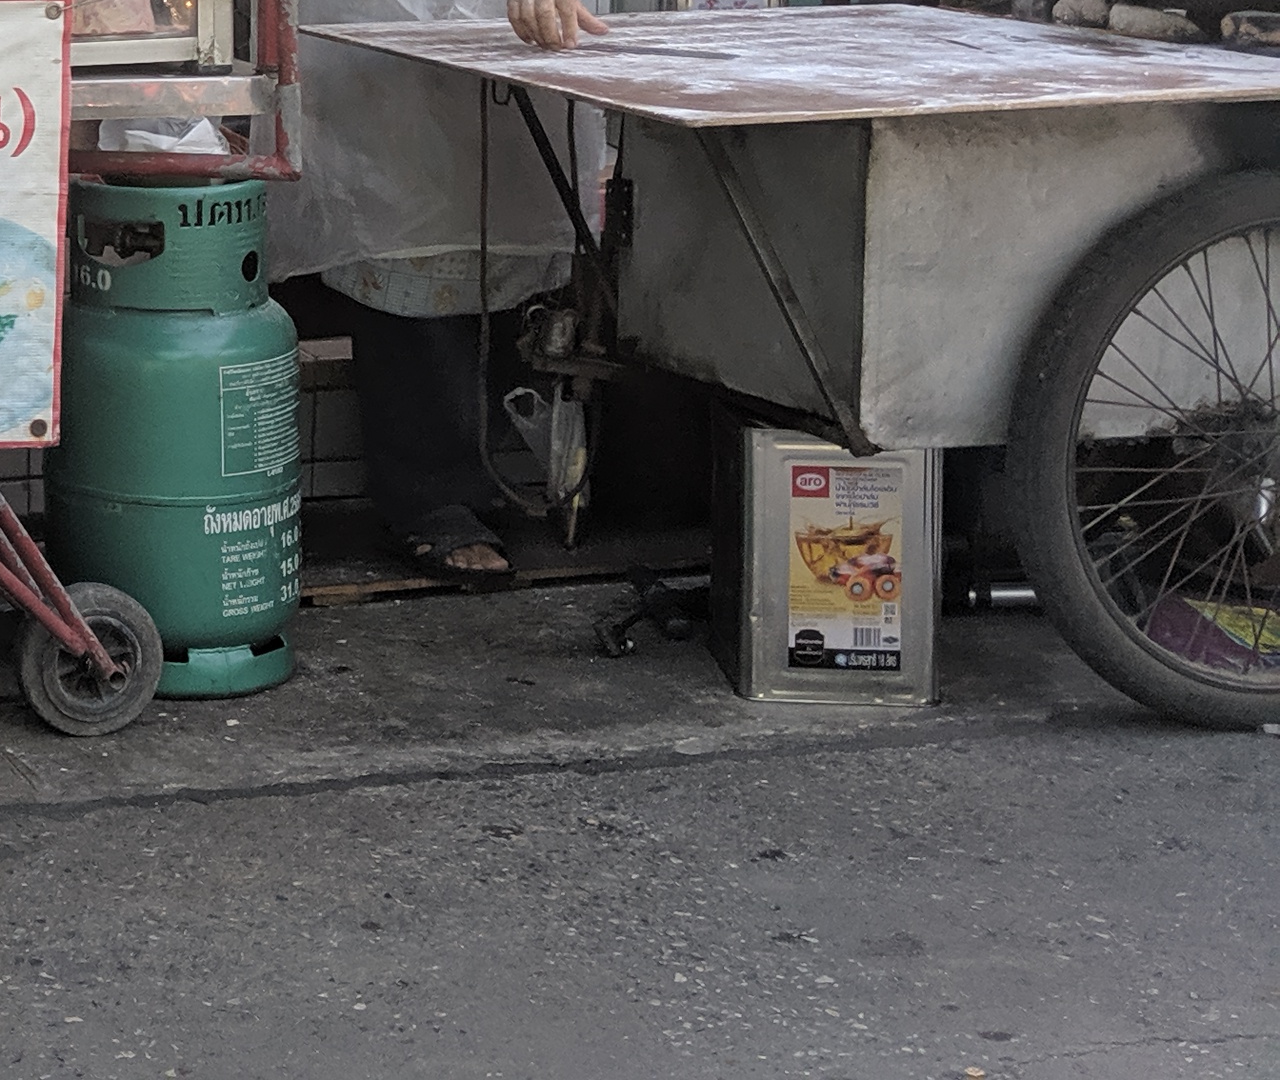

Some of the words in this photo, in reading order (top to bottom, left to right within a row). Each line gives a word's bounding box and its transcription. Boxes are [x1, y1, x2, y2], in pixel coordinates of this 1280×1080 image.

[800, 477, 823, 487] aro
[221, 554, 240, 564] TARE
[280, 553, 299, 578] 15.0
[222, 581, 237, 591] NET
[222, 606, 249, 618] GROSS
